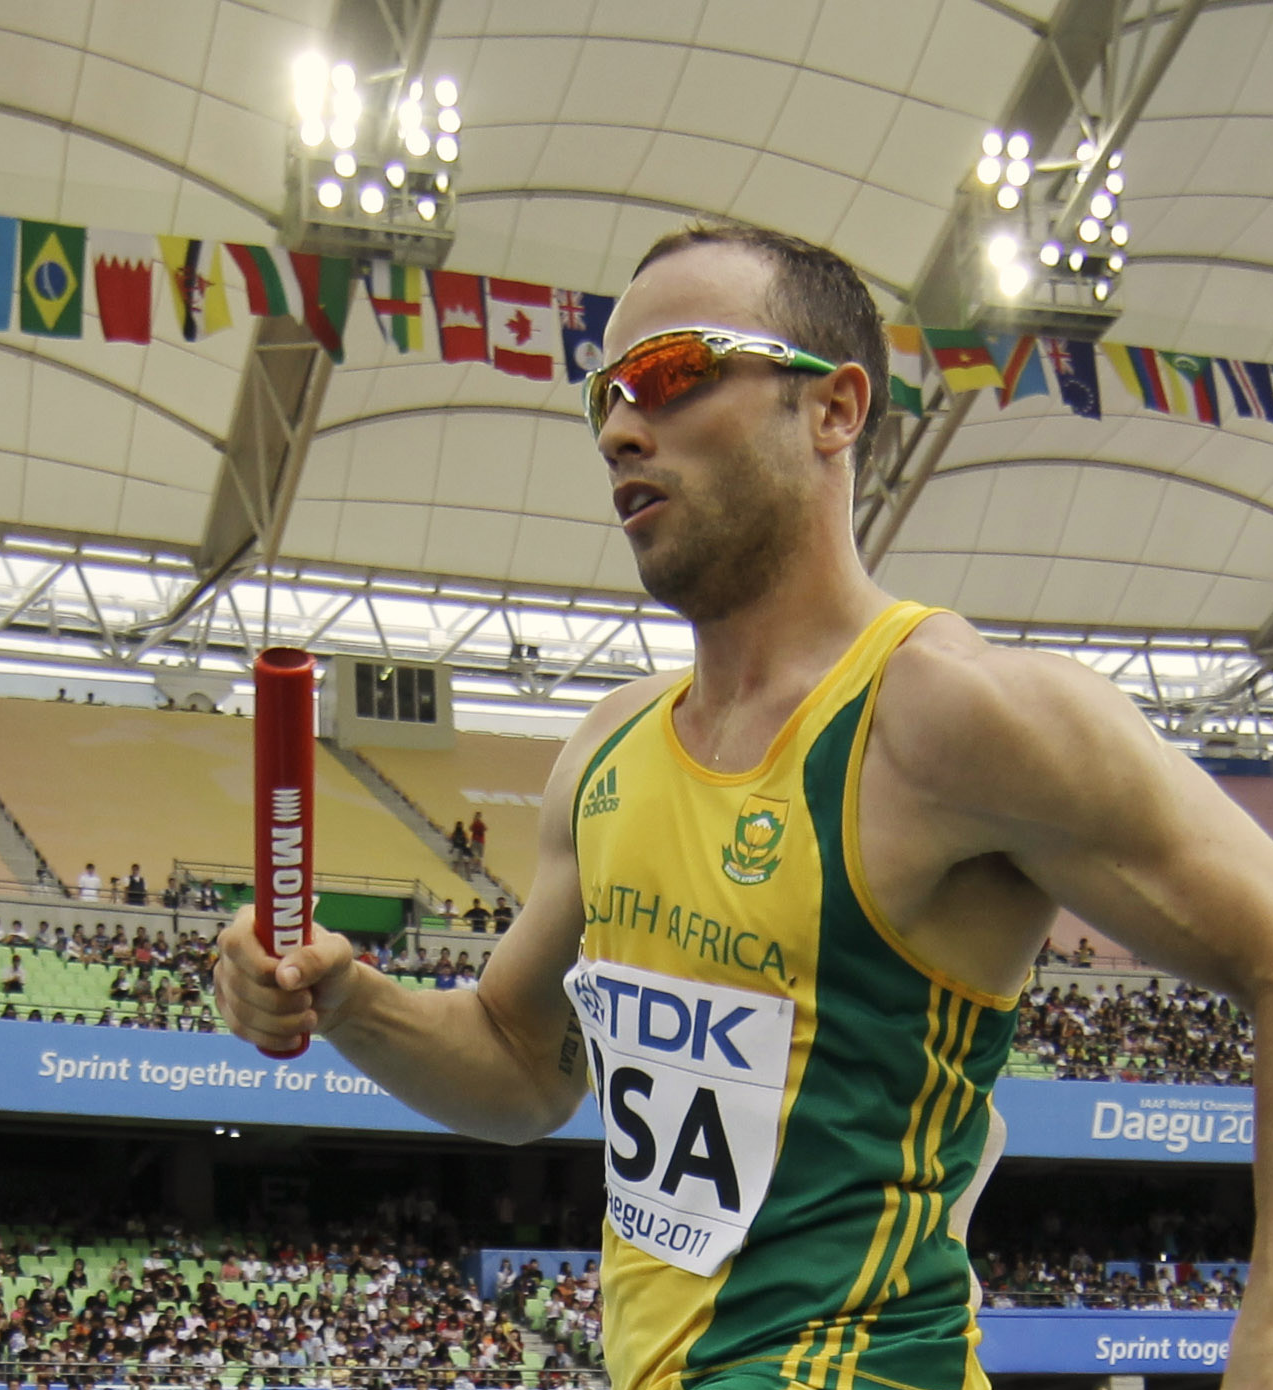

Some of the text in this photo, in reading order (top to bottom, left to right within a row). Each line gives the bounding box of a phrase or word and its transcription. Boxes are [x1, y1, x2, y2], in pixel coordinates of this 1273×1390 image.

[667, 905, 786, 981] AFRICA
[595, 975, 758, 1070] TDK
[38, 1050, 130, 1083] Sprint
[139, 1060, 268, 1091] together
[274, 1065, 317, 1092] for
[1091, 1102, 1214, 1153] Daegu
[655, 1218, 711, 1258] 2011
[1095, 1336, 1171, 1365] Sprint
